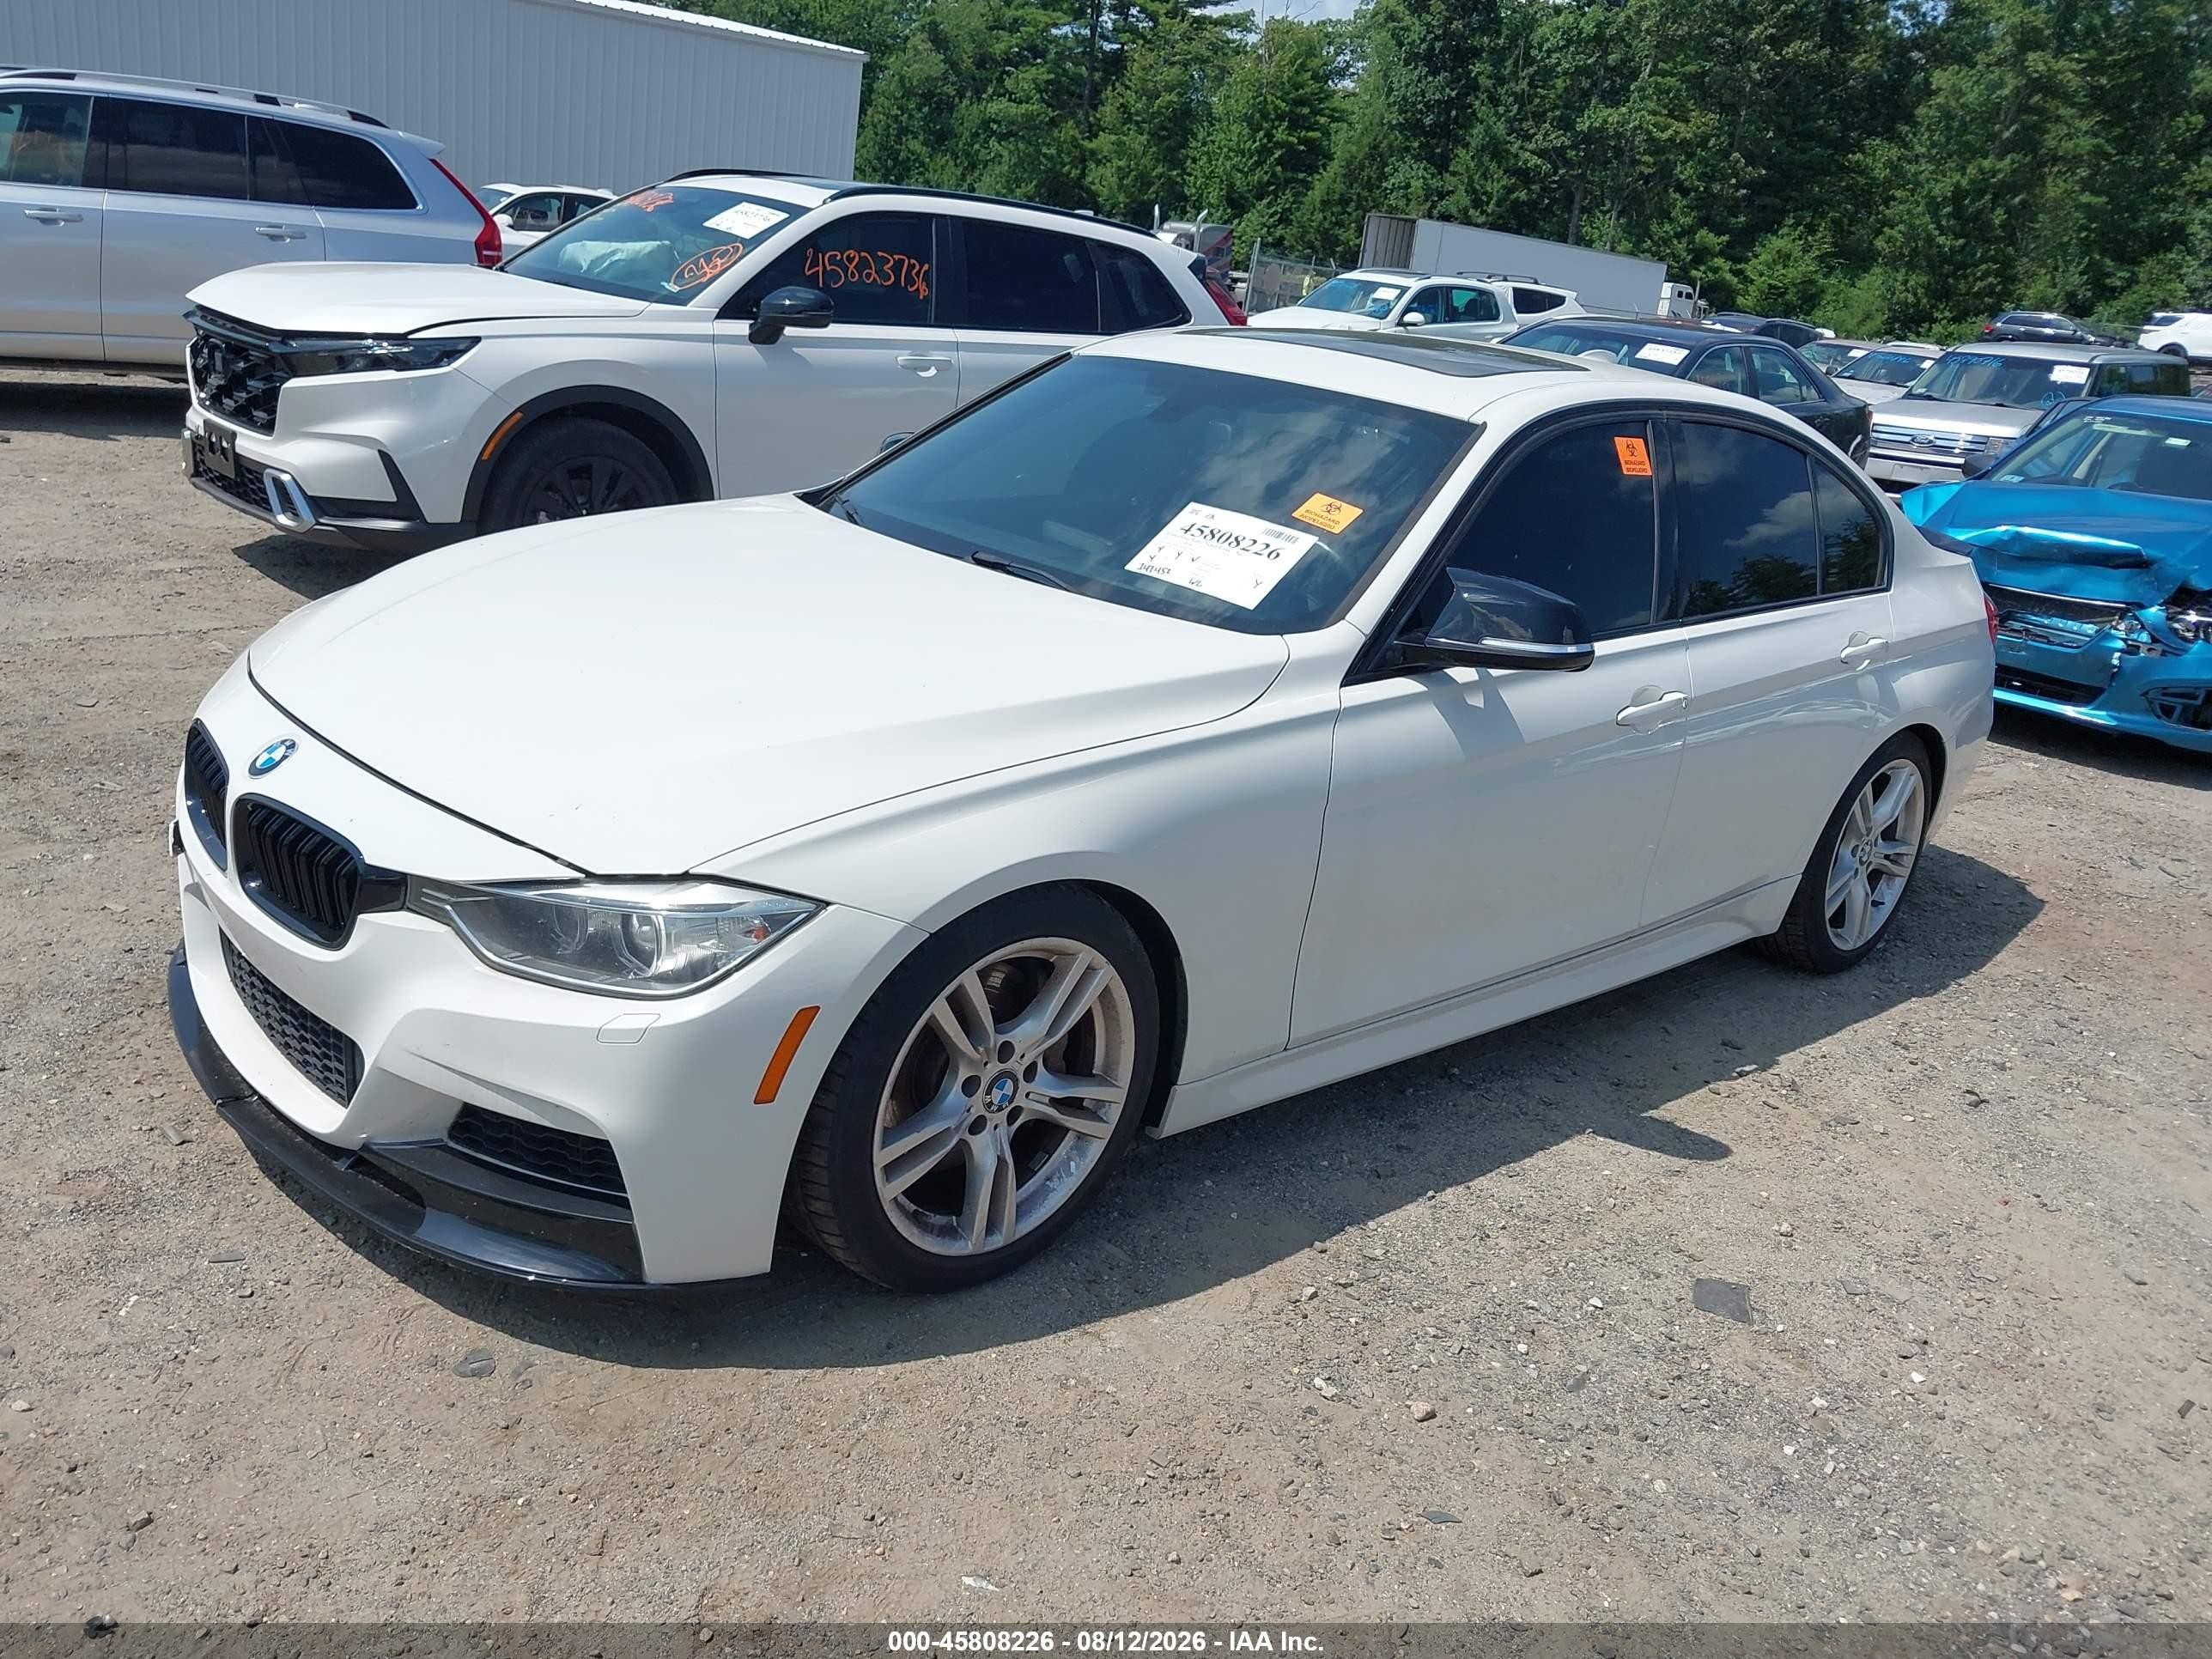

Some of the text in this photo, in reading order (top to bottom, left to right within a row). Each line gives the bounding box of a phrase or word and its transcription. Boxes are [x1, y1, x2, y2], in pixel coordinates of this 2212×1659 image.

[804, 247, 930, 300] 45823736
[1305, 509, 1340, 526] BIOHAZARD
[1180, 522, 1286, 561] 45808226
